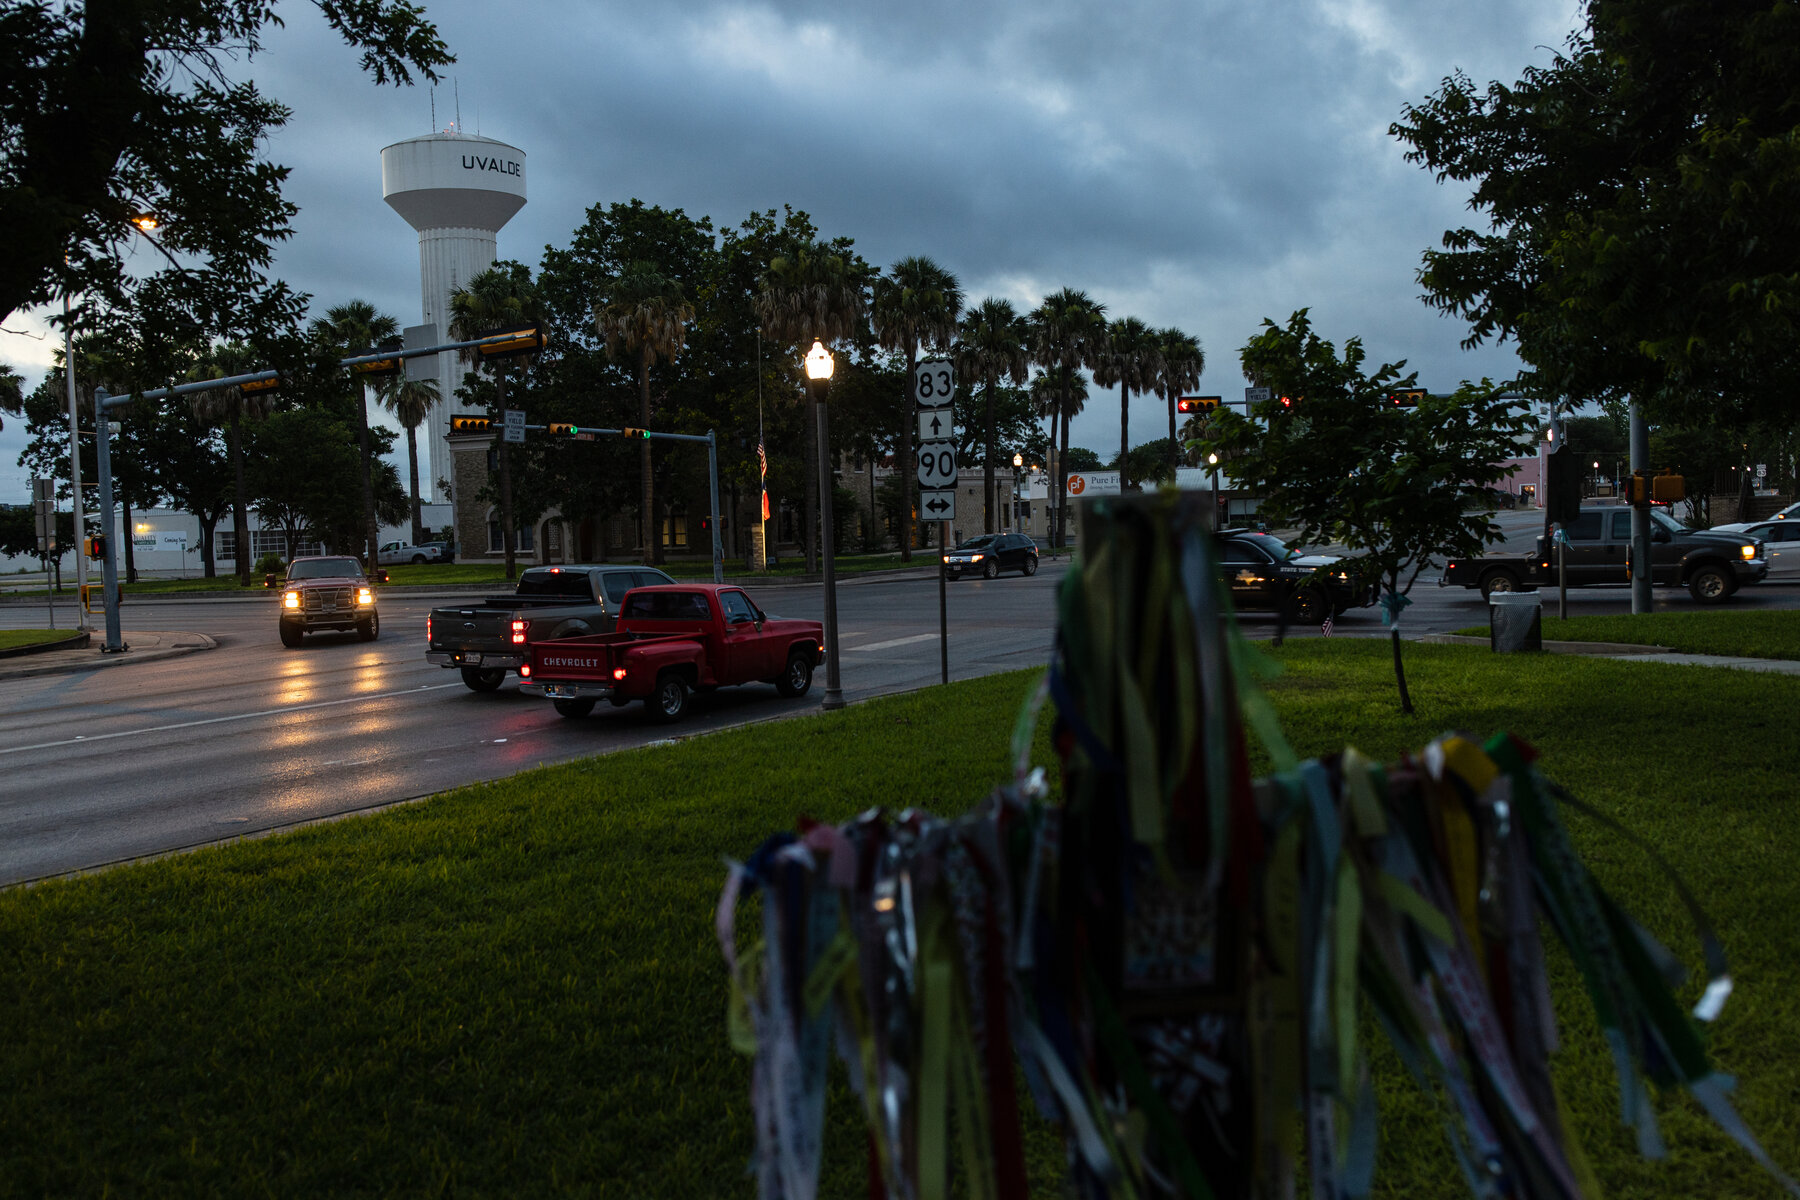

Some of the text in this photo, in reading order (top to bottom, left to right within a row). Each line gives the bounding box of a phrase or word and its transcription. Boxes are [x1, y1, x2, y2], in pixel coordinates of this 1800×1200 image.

[462, 155, 521, 178] UVALDE
[919, 371, 951, 398] 83
[921, 451, 953, 477] 90
[1091, 476, 1108, 484] Pure
[543, 657, 599, 667] CHEVROLET
